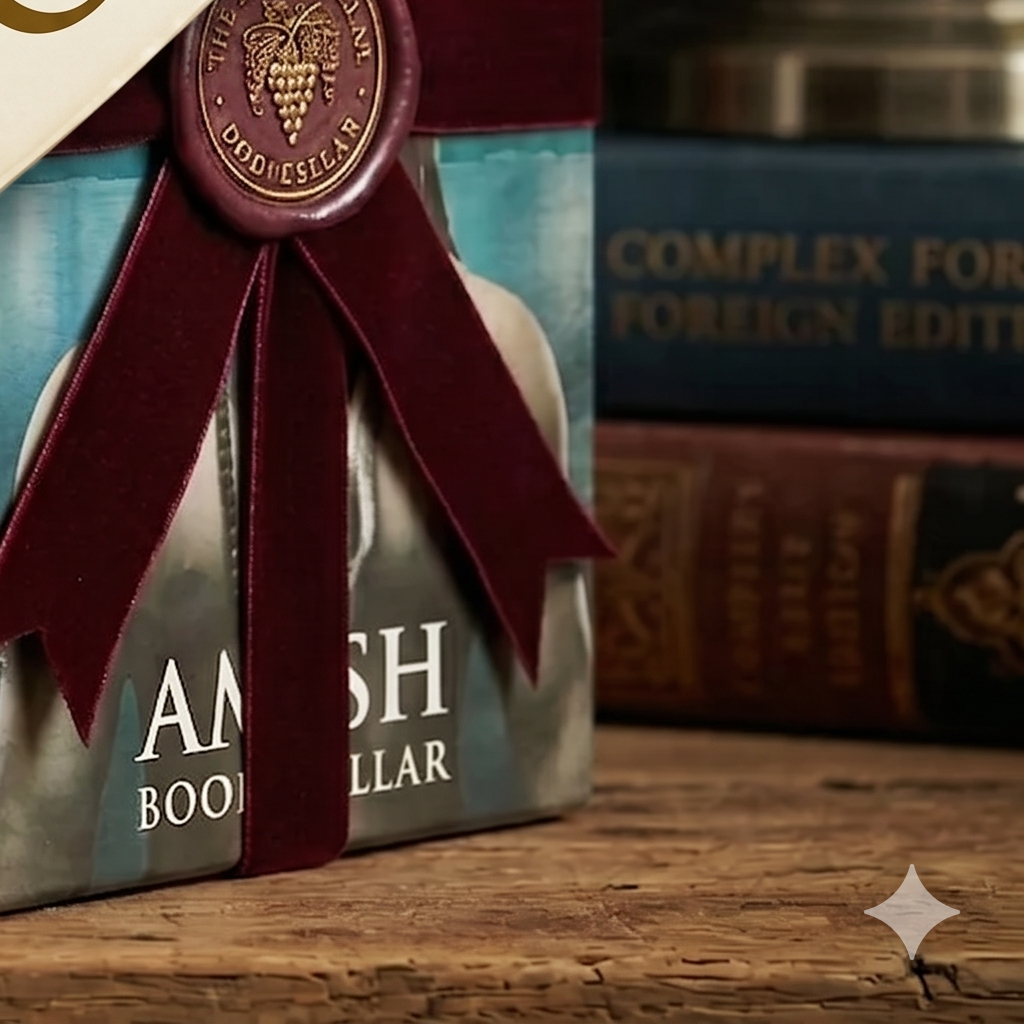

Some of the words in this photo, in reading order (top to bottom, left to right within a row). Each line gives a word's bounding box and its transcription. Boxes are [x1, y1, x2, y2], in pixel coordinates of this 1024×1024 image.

[606, 231, 890, 283] COMPLEX
[610, 294, 858, 344] FOREIGN
[138, 773, 244, 831] BOO
